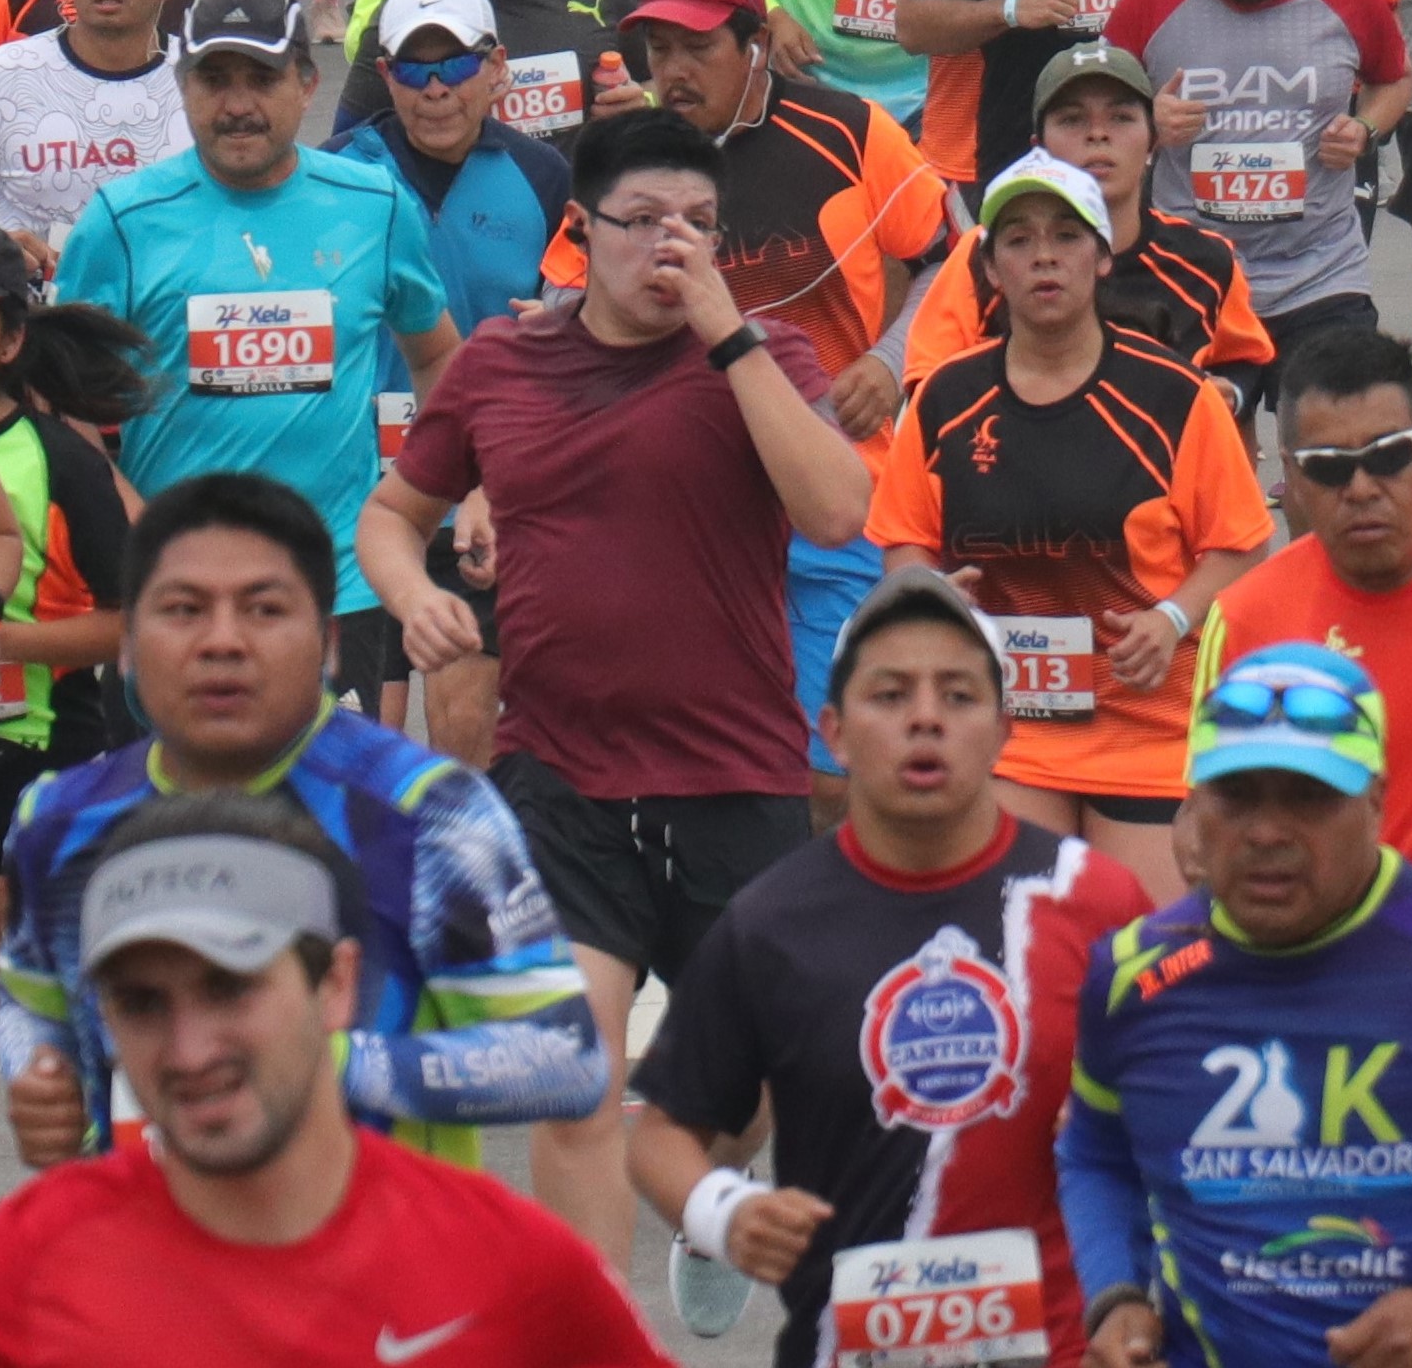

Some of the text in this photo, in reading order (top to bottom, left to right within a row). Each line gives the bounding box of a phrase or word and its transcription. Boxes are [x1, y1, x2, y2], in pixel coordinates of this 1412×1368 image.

[511, 69, 546, 85] Xela
[1181, 66, 1317, 106] BAM
[1197, 104, 1313, 131] unners
[21, 137, 137, 173] UTIAQ
[1238, 152, 1274, 170] Xela
[1209, 172, 1290, 201] 1476
[248, 305, 293, 324] Xela
[212, 331, 313, 367] 1690
[231, 381, 293, 394] MEDALLA
[1005, 628, 1049, 650] Xela
[890, 1035, 999, 1066] CANTERA
[421, 1050, 464, 1090] EL
[1180, 1147, 1241, 1182] SAN
[916, 1254, 978, 1288] Xela
[864, 1288, 1015, 1348] 0796
